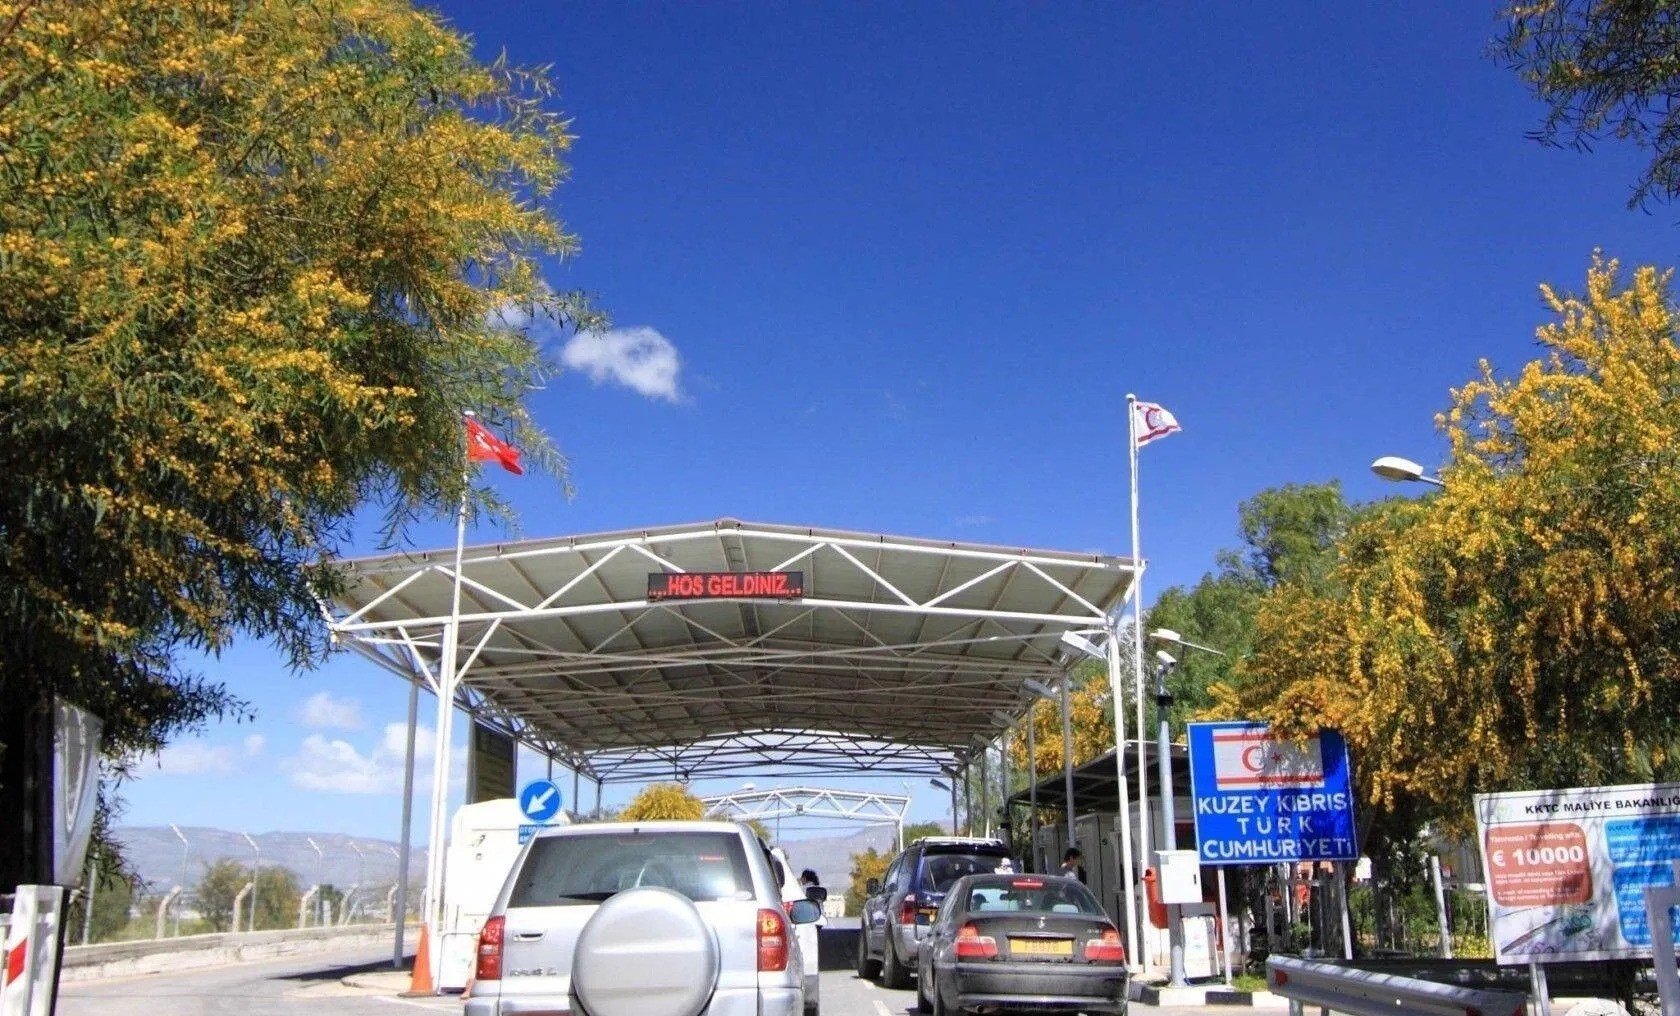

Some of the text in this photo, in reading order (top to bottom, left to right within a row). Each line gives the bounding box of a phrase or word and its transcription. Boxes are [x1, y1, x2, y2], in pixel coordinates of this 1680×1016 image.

[1199, 792, 1347, 815] KUZEY KIBRIS
[1525, 804, 1559, 815] KKTC
[1492, 845, 1584, 867] € 10000
